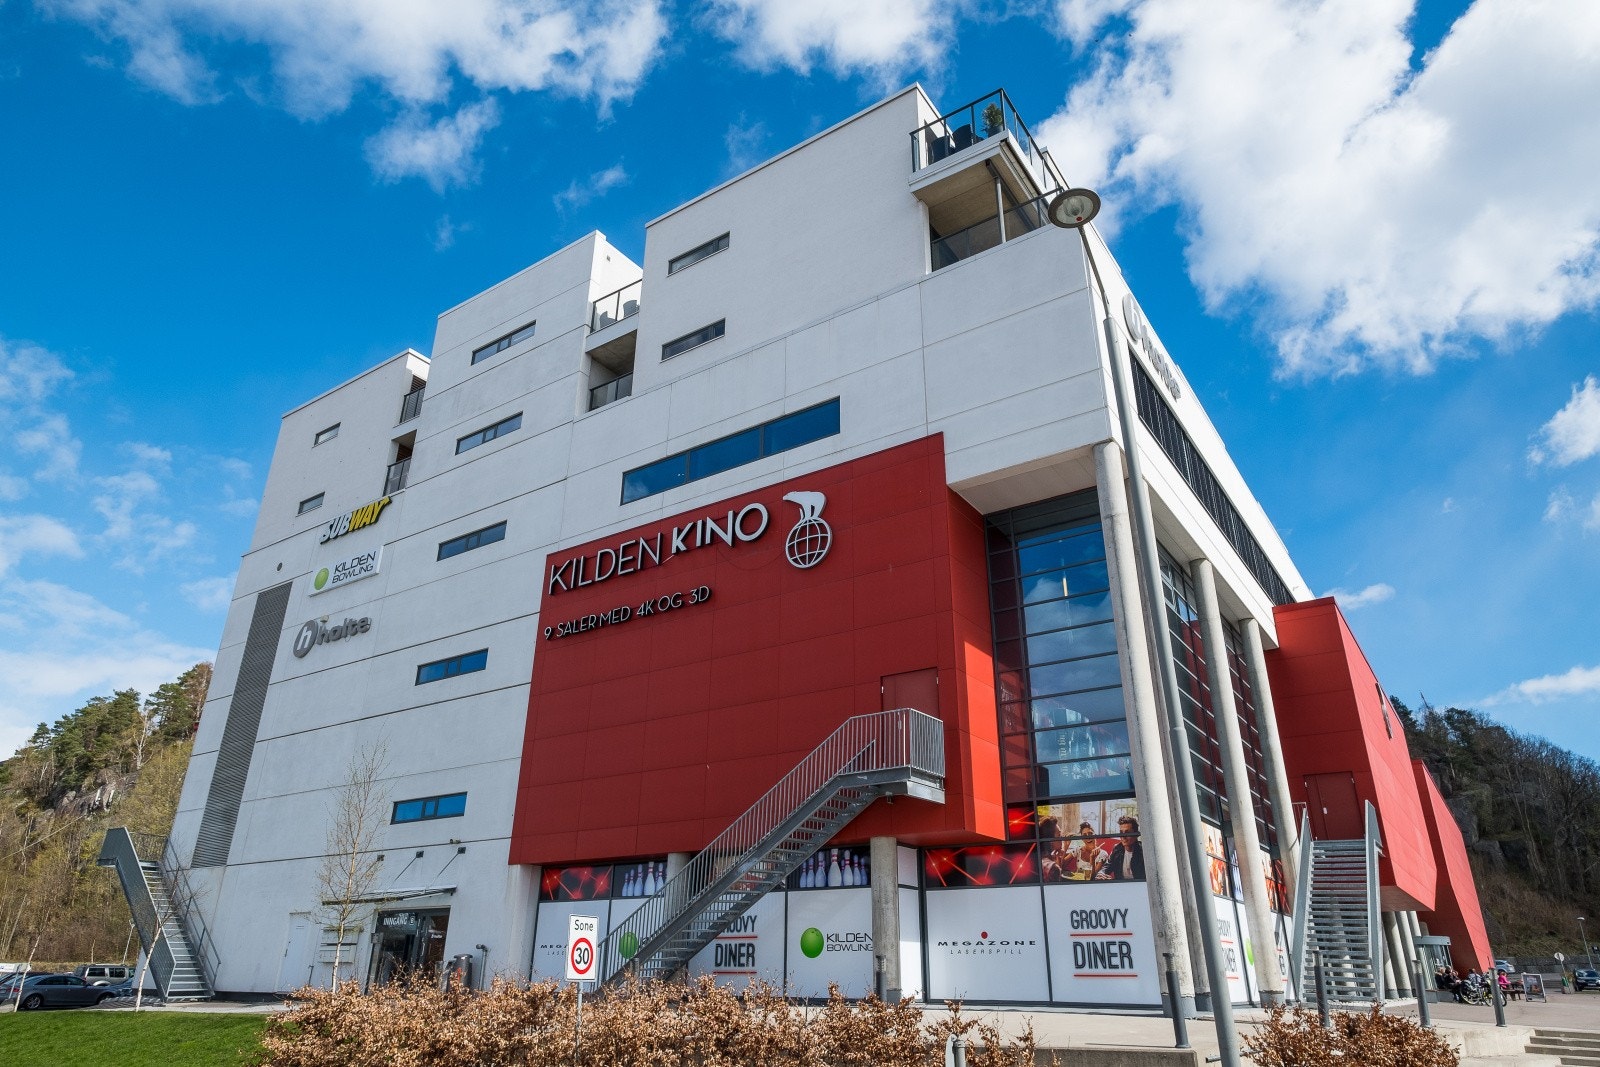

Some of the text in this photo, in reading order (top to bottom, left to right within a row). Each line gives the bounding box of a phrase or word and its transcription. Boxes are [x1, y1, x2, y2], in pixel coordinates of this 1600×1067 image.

[320, 496, 391, 544] SUBWAY
[549, 503, 769, 595] KILDEN KINO
[332, 563, 374, 584] BOWLING
[334, 551, 377, 575] KILDEN
[544, 585, 710, 640] 9 SALER MED 4K OG 3D
[316, 616, 371, 645] halte
[574, 919, 594, 932] Sone
[1070, 908, 1128, 930] GROOVY
[575, 947, 590, 965] 30
[714, 943, 756, 967] DINER
[826, 943, 873, 952] BOWLING
[1073, 941, 1133, 969] DINER
